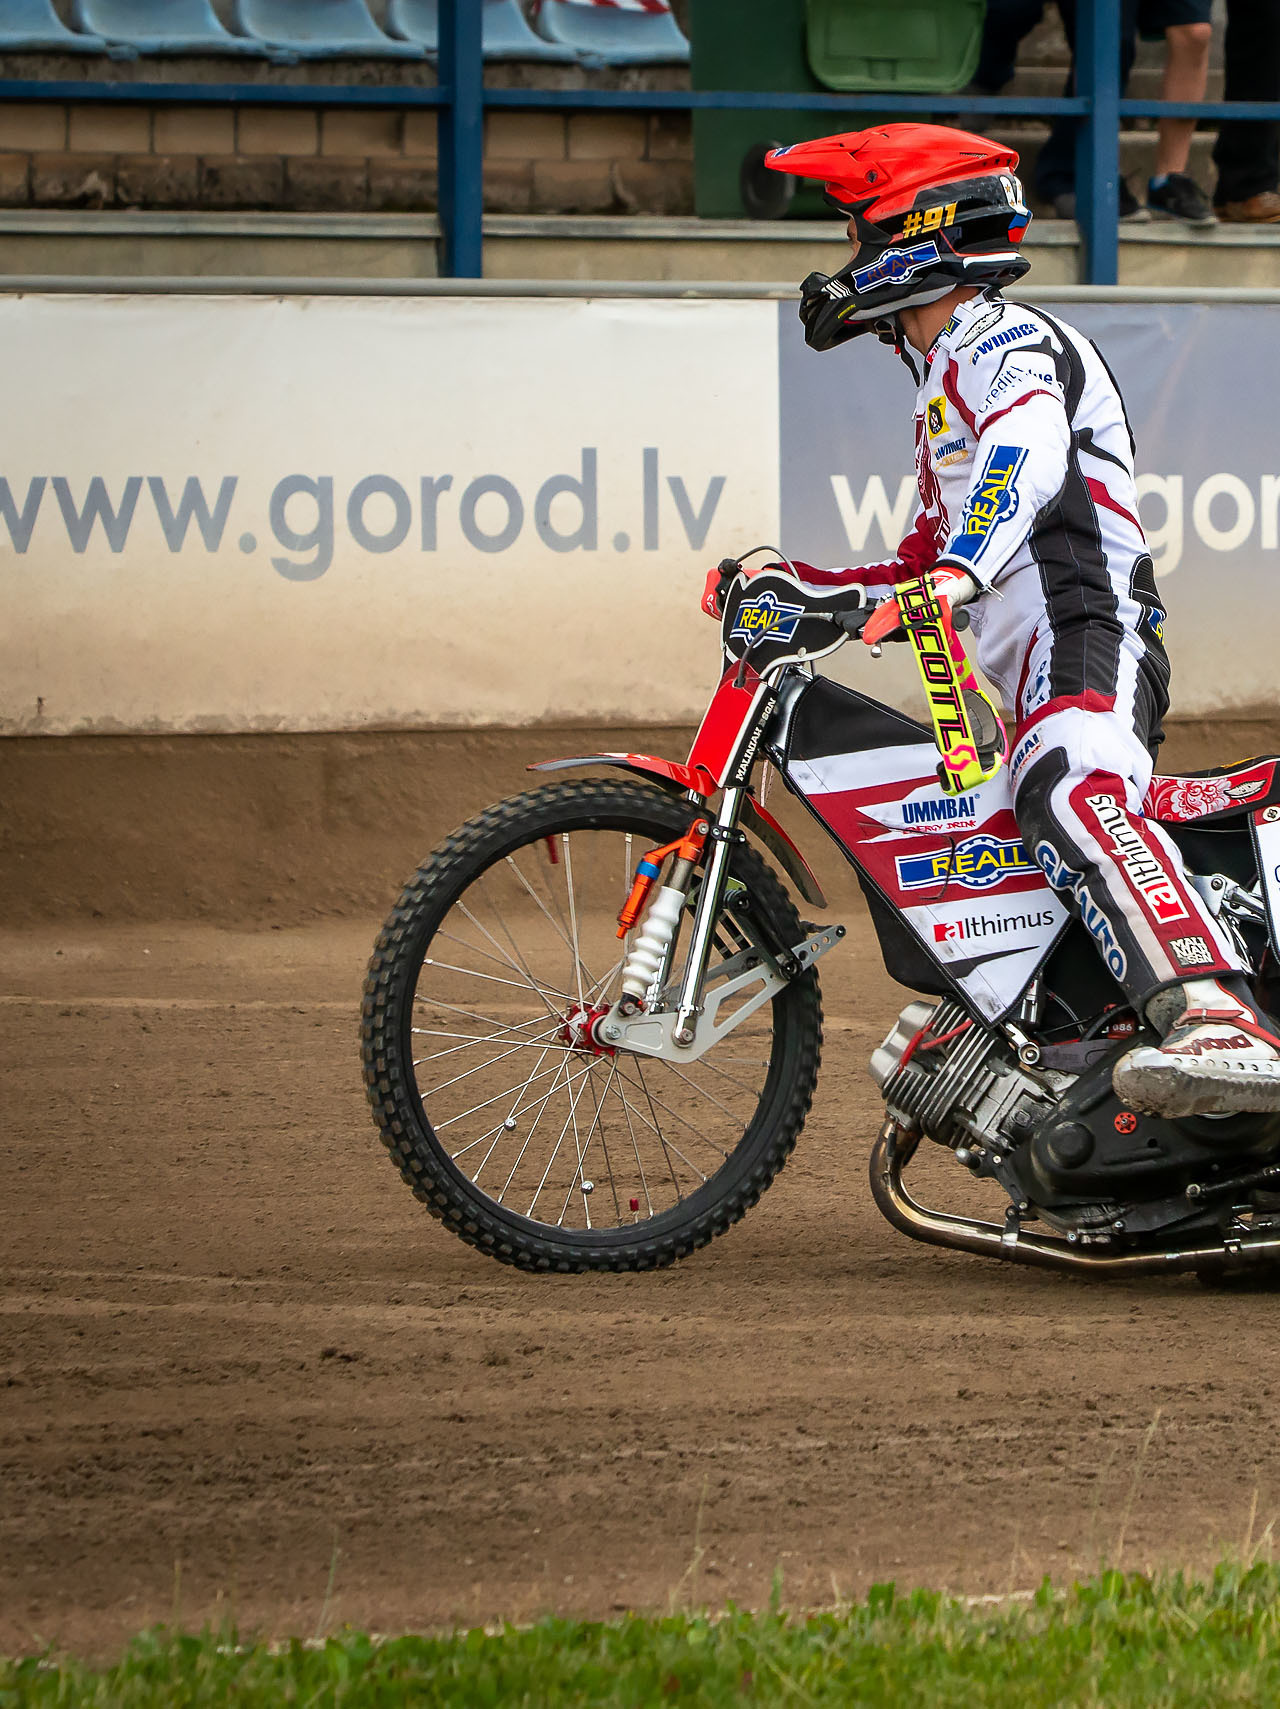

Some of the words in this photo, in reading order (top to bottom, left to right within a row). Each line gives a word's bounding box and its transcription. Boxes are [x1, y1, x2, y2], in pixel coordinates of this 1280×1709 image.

[902, 200, 957, 239] #91
[967, 464, 1014, 536] REALL
[739, 608, 781, 631] REALL
[902, 796, 976, 824] UMMBA!
[931, 846, 1029, 877] REALL
[1089, 794, 1185, 920] althimus
[934, 910, 1055, 943] althimus
